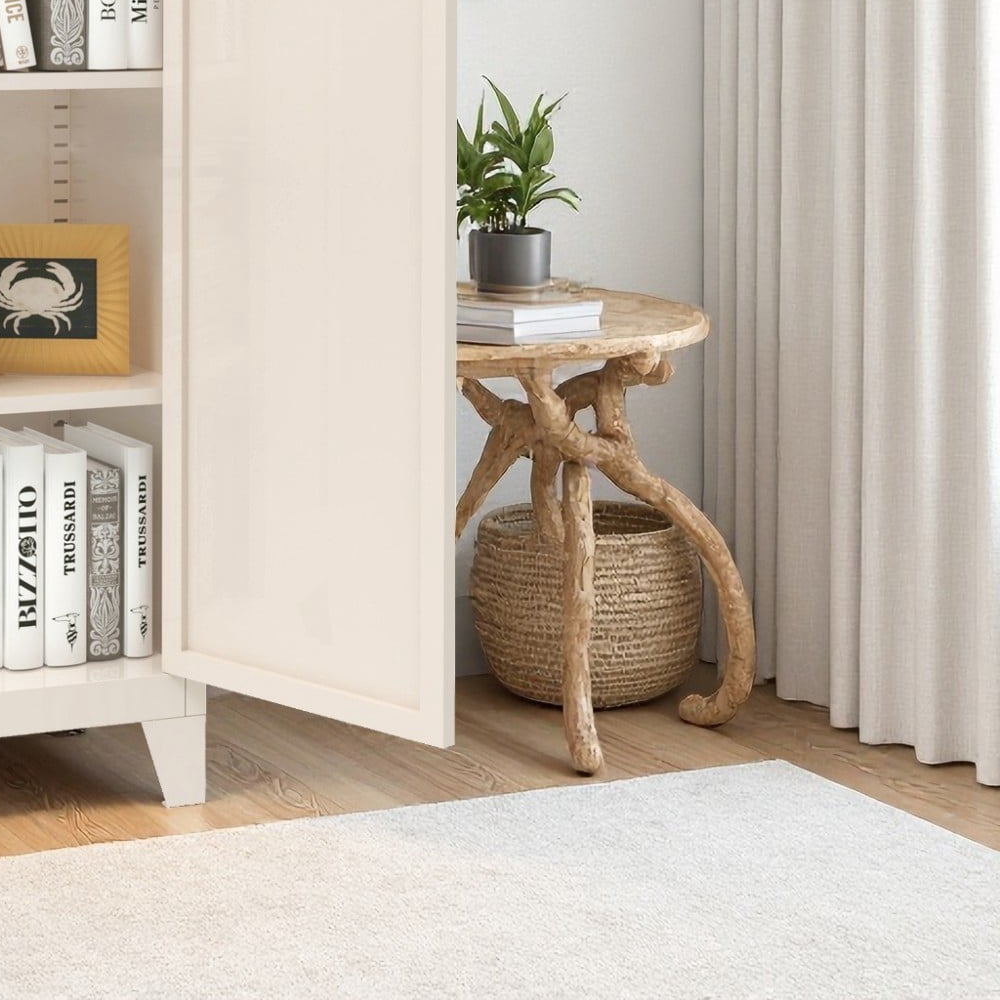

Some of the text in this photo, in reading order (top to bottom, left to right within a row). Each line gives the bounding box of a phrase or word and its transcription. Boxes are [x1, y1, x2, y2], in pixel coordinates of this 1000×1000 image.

[63, 480, 76, 576] TRUSSARDI
[92, 496, 117, 504] MEMOIR
[138, 475, 147, 568] TRUSSARDI
